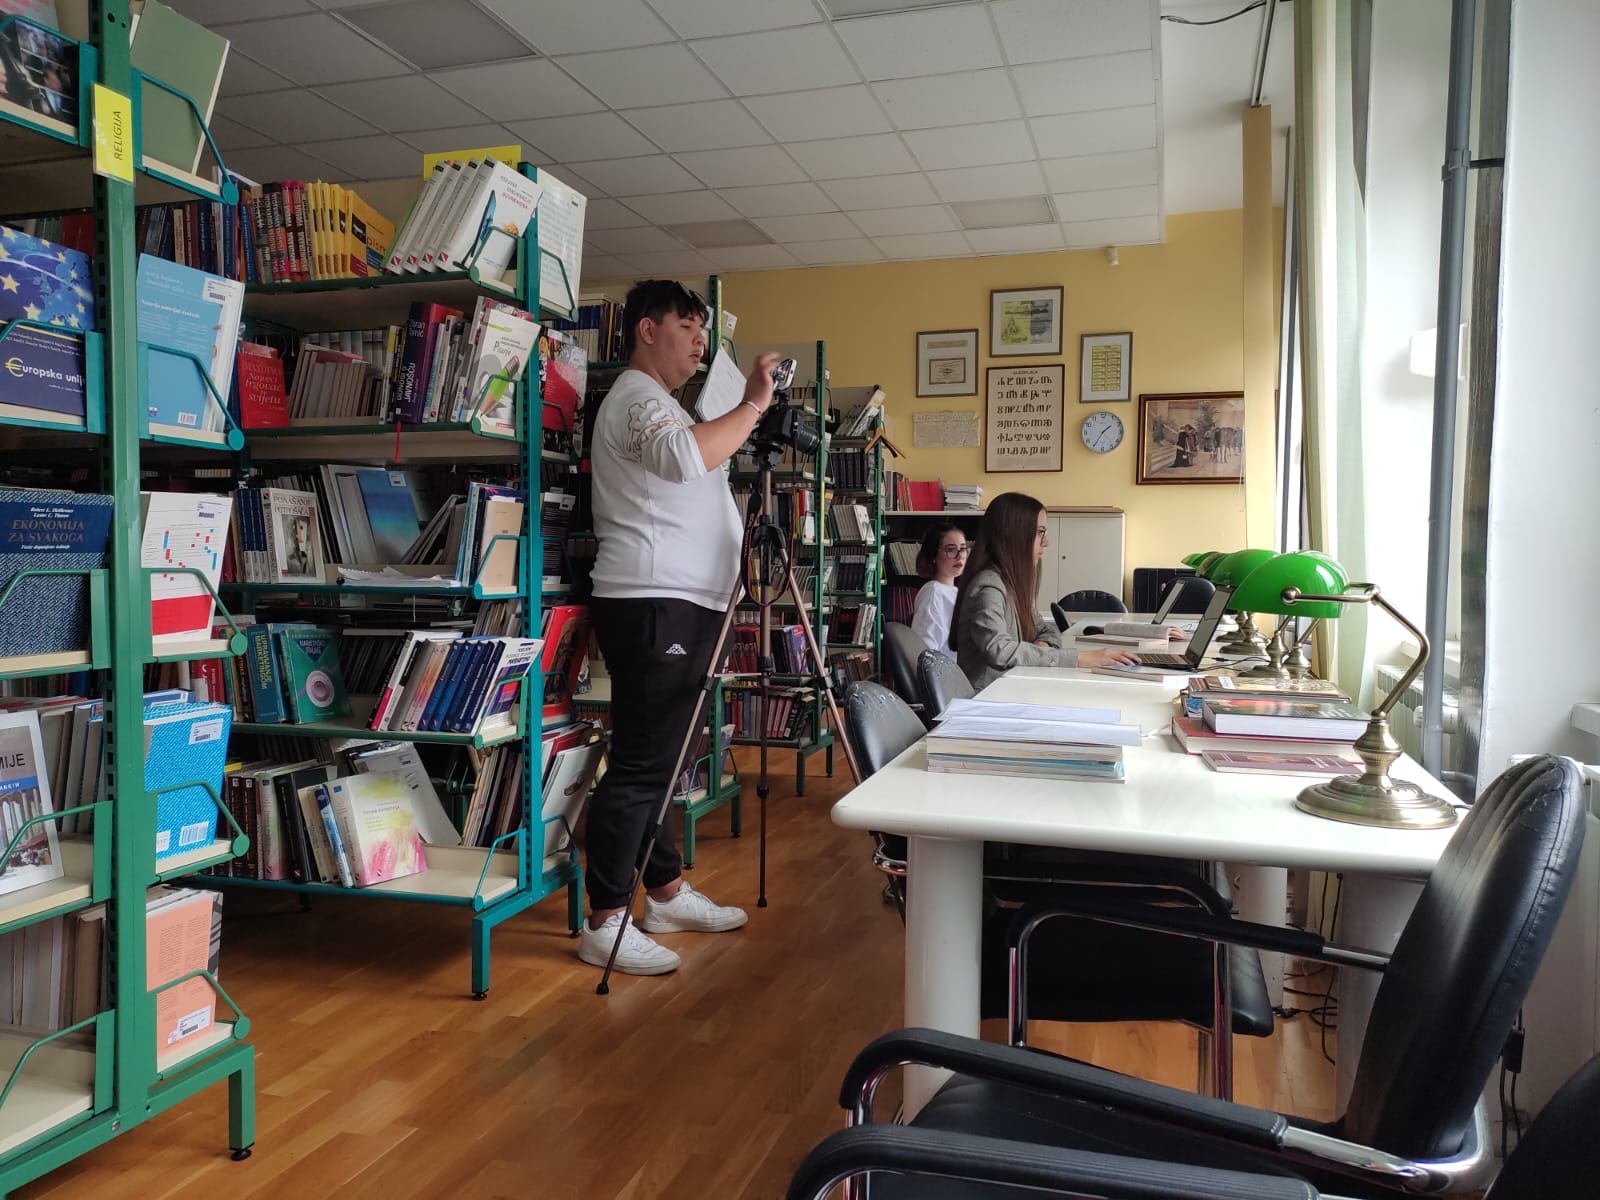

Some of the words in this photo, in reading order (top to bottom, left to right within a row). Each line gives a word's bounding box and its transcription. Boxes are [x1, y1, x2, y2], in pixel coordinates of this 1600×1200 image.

[112, 110, 123, 161] RELIGIJA
[65, 373, 84, 387] unij
[404, 362, 416, 403] JAVNOŠĆU
[8, 532, 24, 542] ZA
[29, 532, 84, 542] SVAKOGA
[12, 519, 84, 530] EKONOMIJA
[256, 635, 268, 690] MARKETINGOM
